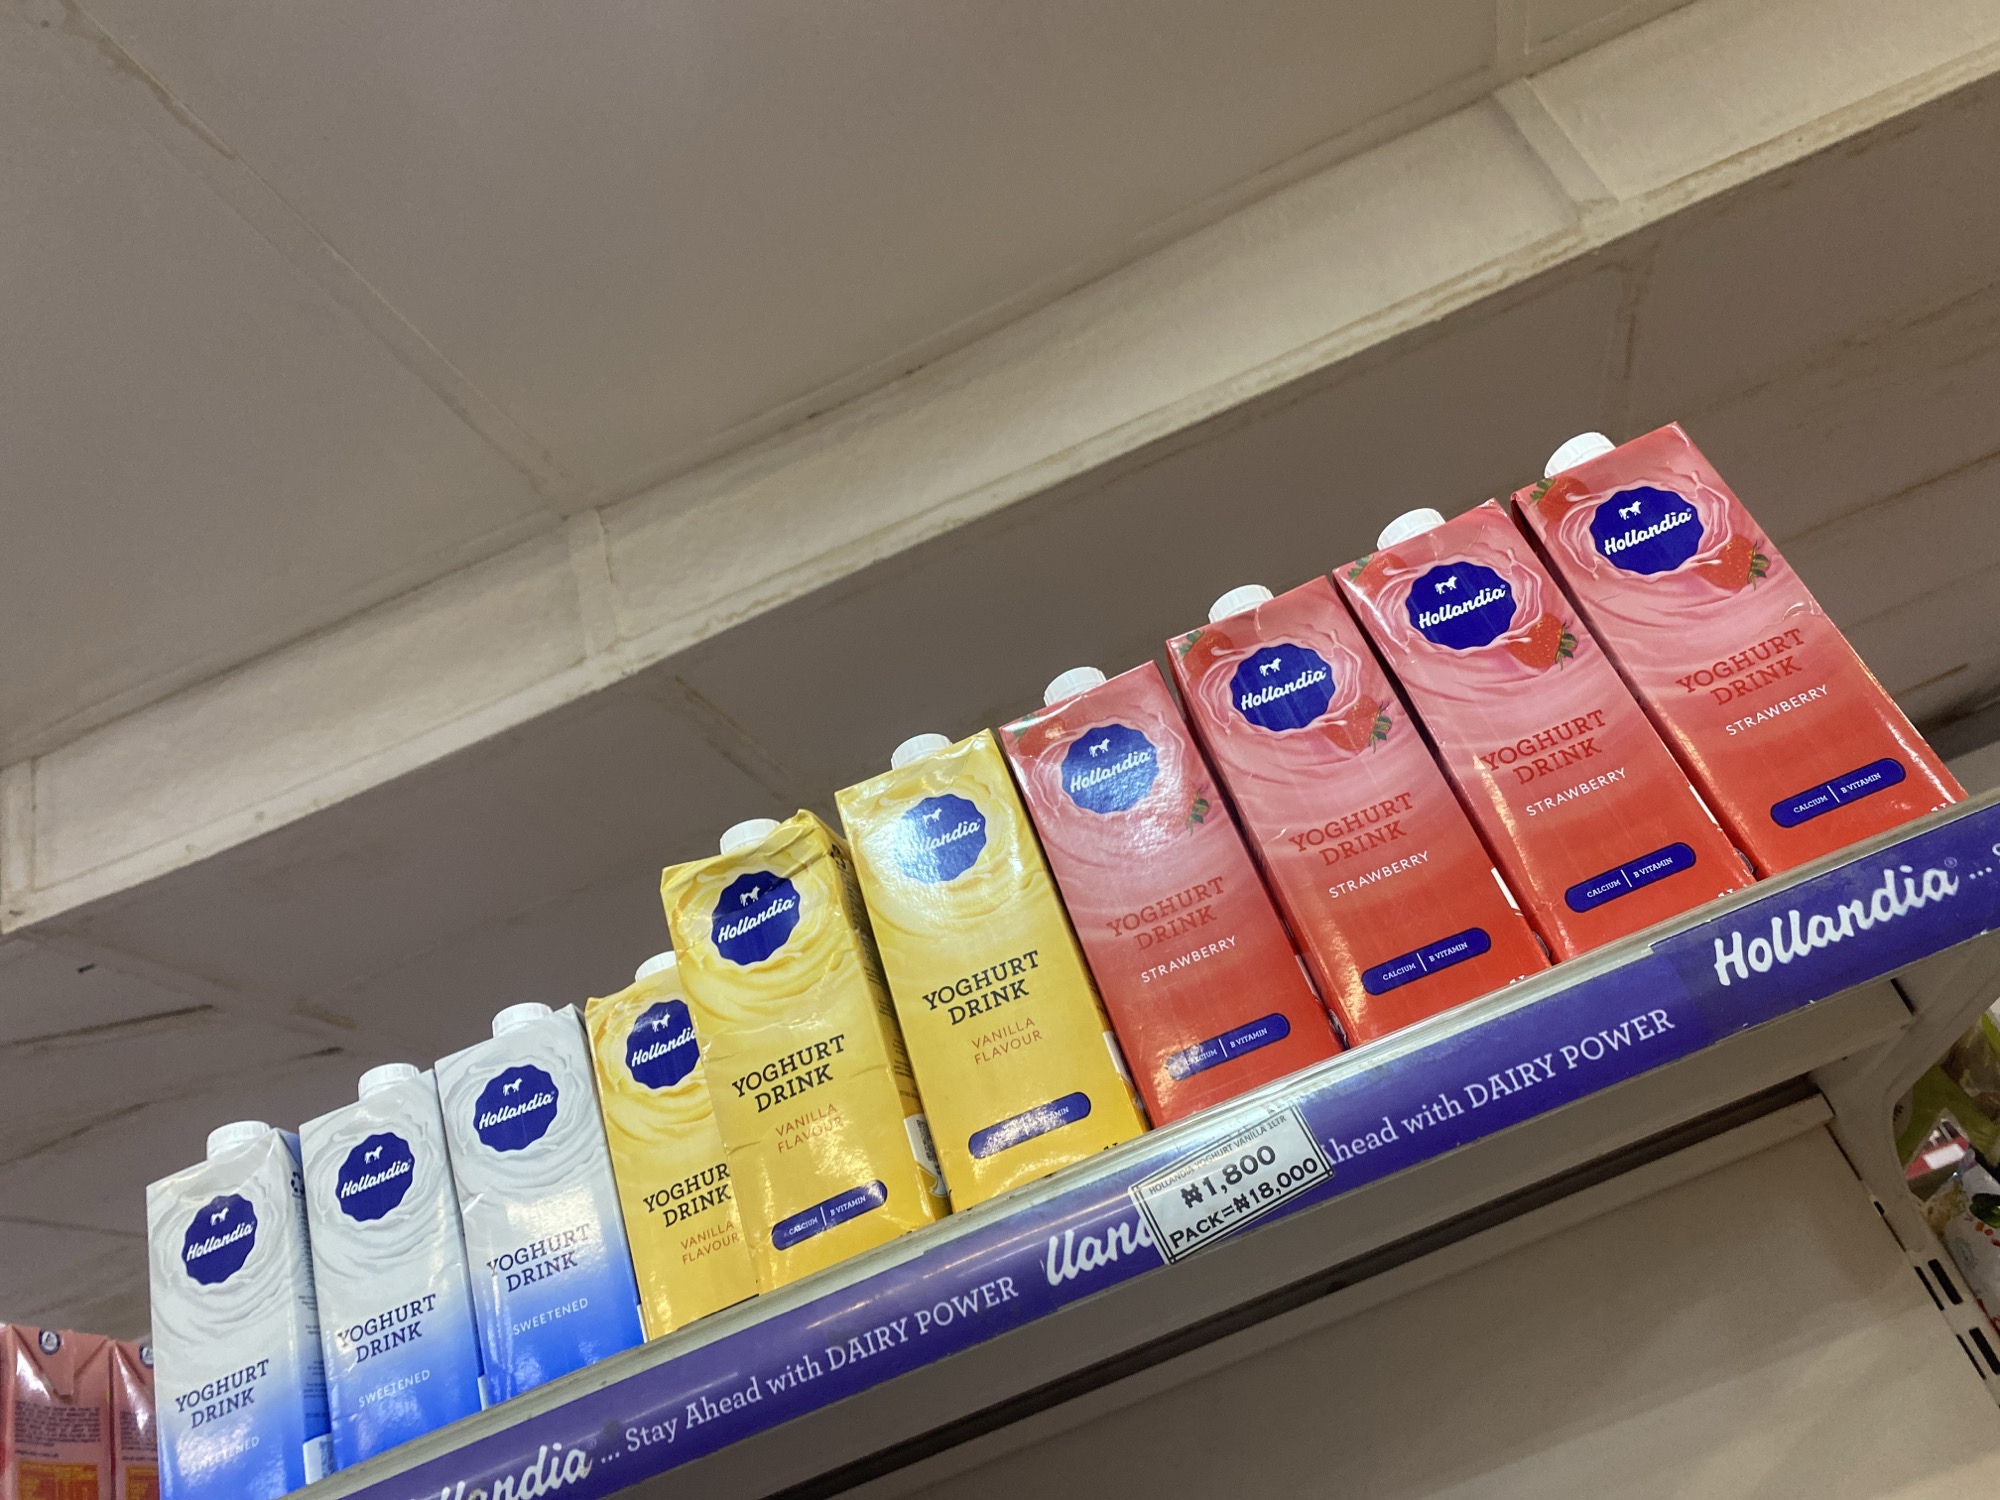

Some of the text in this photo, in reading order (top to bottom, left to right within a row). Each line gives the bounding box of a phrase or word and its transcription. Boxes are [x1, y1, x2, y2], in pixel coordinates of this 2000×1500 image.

[1603, 508, 1692, 556] Hollandia
[1418, 584, 1506, 629] Hollandia
[1675, 628, 1806, 695] YOGHURT
[1710, 656, 1803, 706] DRINK
[1241, 668, 1326, 710] Hollandia
[1725, 685, 1829, 736] STRAWBERRY
[1480, 709, 1606, 772] YOGHURT
[1513, 738, 1602, 785] DRINK
[1070, 750, 1152, 793] Hollandia
[1526, 767, 1627, 817] STRAWBERRY
[1847, 772, 1882, 791] VITAMIN
[1288, 792, 1414, 853] YOGHURT
[1793, 794, 1828, 814] CALCIUM
[1319, 824, 1407, 866] DRINK
[1329, 850, 1429, 899] STRAWBERRY
[1640, 857, 1674, 877] VITAMIN
[1107, 876, 1224, 937] YOGHURT
[1586, 879, 1621, 899] CALCIUM
[718, 896, 794, 943] Hollandia
[1133, 906, 1218, 951] DRINK
[1714, 865, 1959, 986] Hollandia
[1141, 935, 1237, 983] STRAWBERRY
[1382, 962, 1416, 981] CALCIUM
[1436, 941, 1468, 959] VITAMIN
[922, 951, 1040, 1011] YOGHURT
[948, 978, 1030, 1025] DRINK
[972, 1017, 1036, 1049] VANILLA
[974, 1030, 1043, 1065] FLAVOUR
[1236, 1027, 1268, 1046] VITAMIN
[732, 1034, 846, 1099] YOGHURT
[1184, 1048, 1218, 1068] LCIUM
[1401, 1093, 1465, 1134] with
[1463, 1053, 1557, 1109] DAIRY
[1559, 1008, 1675, 1070] POWER
[754, 1062, 834, 1113] DRINK
[479, 1091, 554, 1130] Hollandia
[775, 1103, 838, 1137] VANILLA
[777, 1116, 844, 1153] FLAVOUR
[1148, 1115, 1287, 1195] HOLLANDIA YOGHURT VANILLA 1LTR
[340, 1160, 411, 1199] Hollandia
[643, 1162, 731, 1213] YOGHUR
[663, 1184, 732, 1228] DRINK
[788, 1216, 818, 1235] CALCIUM
[836, 1195, 866, 1213] VITAMIN
[186, 1222, 254, 1261] Hollandia
[486, 1223, 591, 1277] YOGHURT
[680, 1220, 735, 1250] VANILLA
[682, 1232, 739, 1264] FLAVOUR
[506, 1250, 578, 1292] DRINK
[337, 1294, 436, 1349] YOGHURT
[512, 1297, 588, 1336] SWEETENED
[355, 1321, 424, 1364] DRINK
[175, 1359, 270, 1413] YOGHURT
[625, 1417, 678, 1452] Stay
[685, 1376, 763, 1429] Ahead
[766, 1353, 823, 1394] with
[825, 1321, 911, 1371] DAIRY
[914, 1277, 1020, 1335] POWER
[190, 1387, 256, 1429] DRINK
[358, 1369, 431, 1407] SWEETENED
